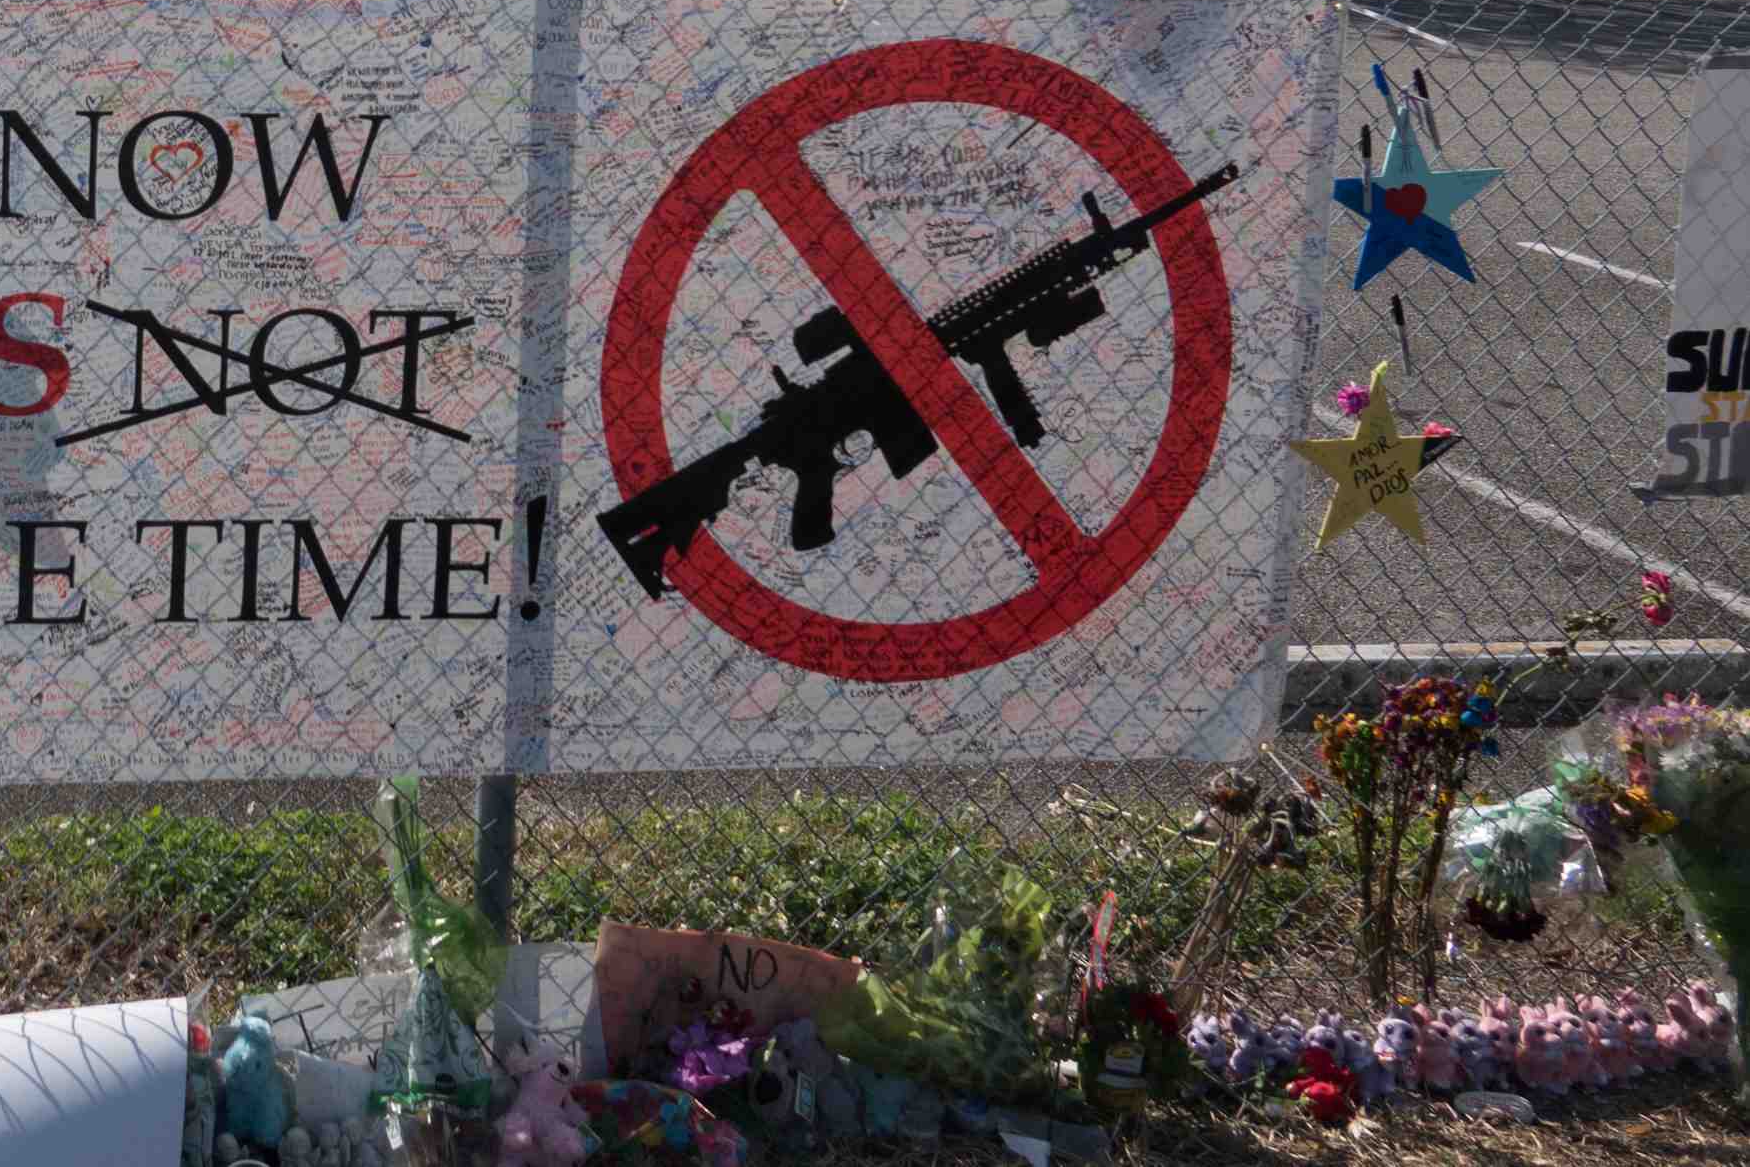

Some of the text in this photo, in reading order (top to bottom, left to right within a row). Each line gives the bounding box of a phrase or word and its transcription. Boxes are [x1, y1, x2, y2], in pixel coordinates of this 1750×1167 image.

[118, 309, 460, 421] NOT
[1666, 328, 1750, 393] SU
[136, 493, 548, 627] TIME!
[717, 943, 779, 994] NO
